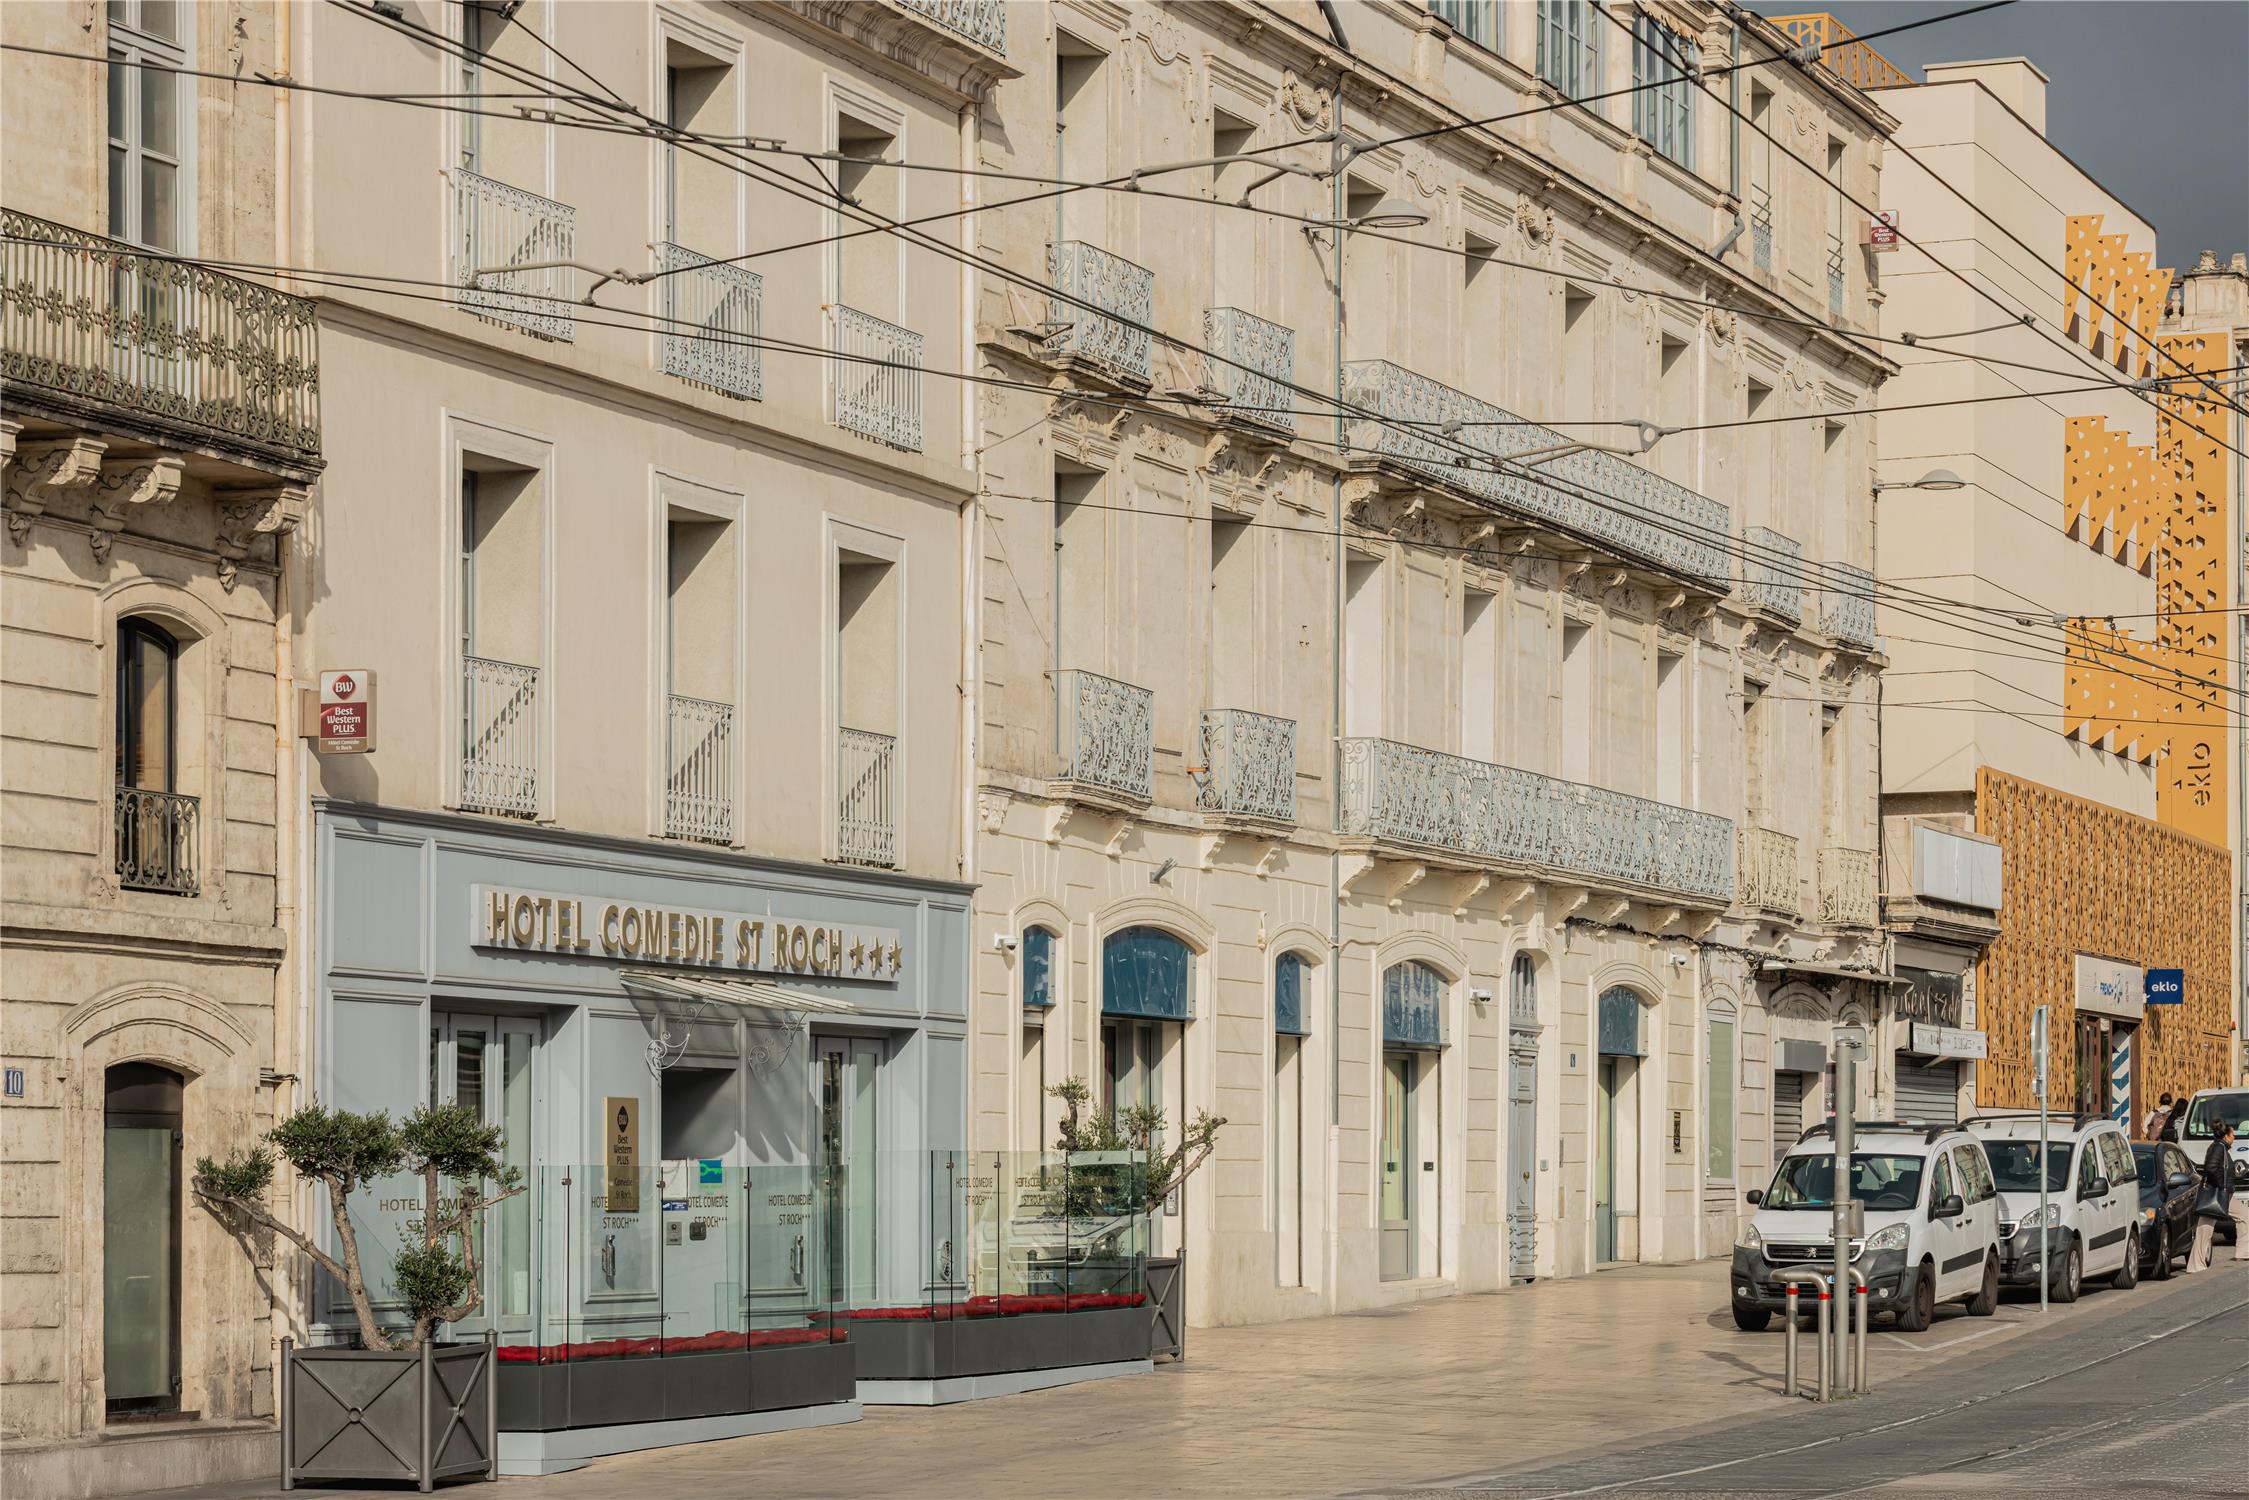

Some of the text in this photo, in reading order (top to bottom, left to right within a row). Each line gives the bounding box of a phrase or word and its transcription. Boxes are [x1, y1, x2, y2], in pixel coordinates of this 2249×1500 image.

[335, 681, 353, 693] BW
[335, 706, 353, 716] Best
[327, 715, 360, 724] Western
[333, 724, 355, 733] PLUS
[2187, 742, 2210, 806] eklo
[487, 892, 842, 972] HOTEL COMEDIE ST ROCH
[2151, 981, 2178, 991] eklo
[8, 1071, 21, 1094] 10
[618, 1135, 629, 1144] Best
[613, 1145, 632, 1154] Western
[616, 1156, 629, 1165] PLUS
[956, 1177, 972, 1188] HOTEL
[380, 1199, 424, 1211] HOTEL
[703, 1195, 728, 1208] COMEDIE
[768, 1193, 812, 1206] HOTEL COMEDIE
[602, 1216, 611, 1229] ST
[779, 1213, 786, 1226] ST
[406, 1220, 422, 1232] ST
